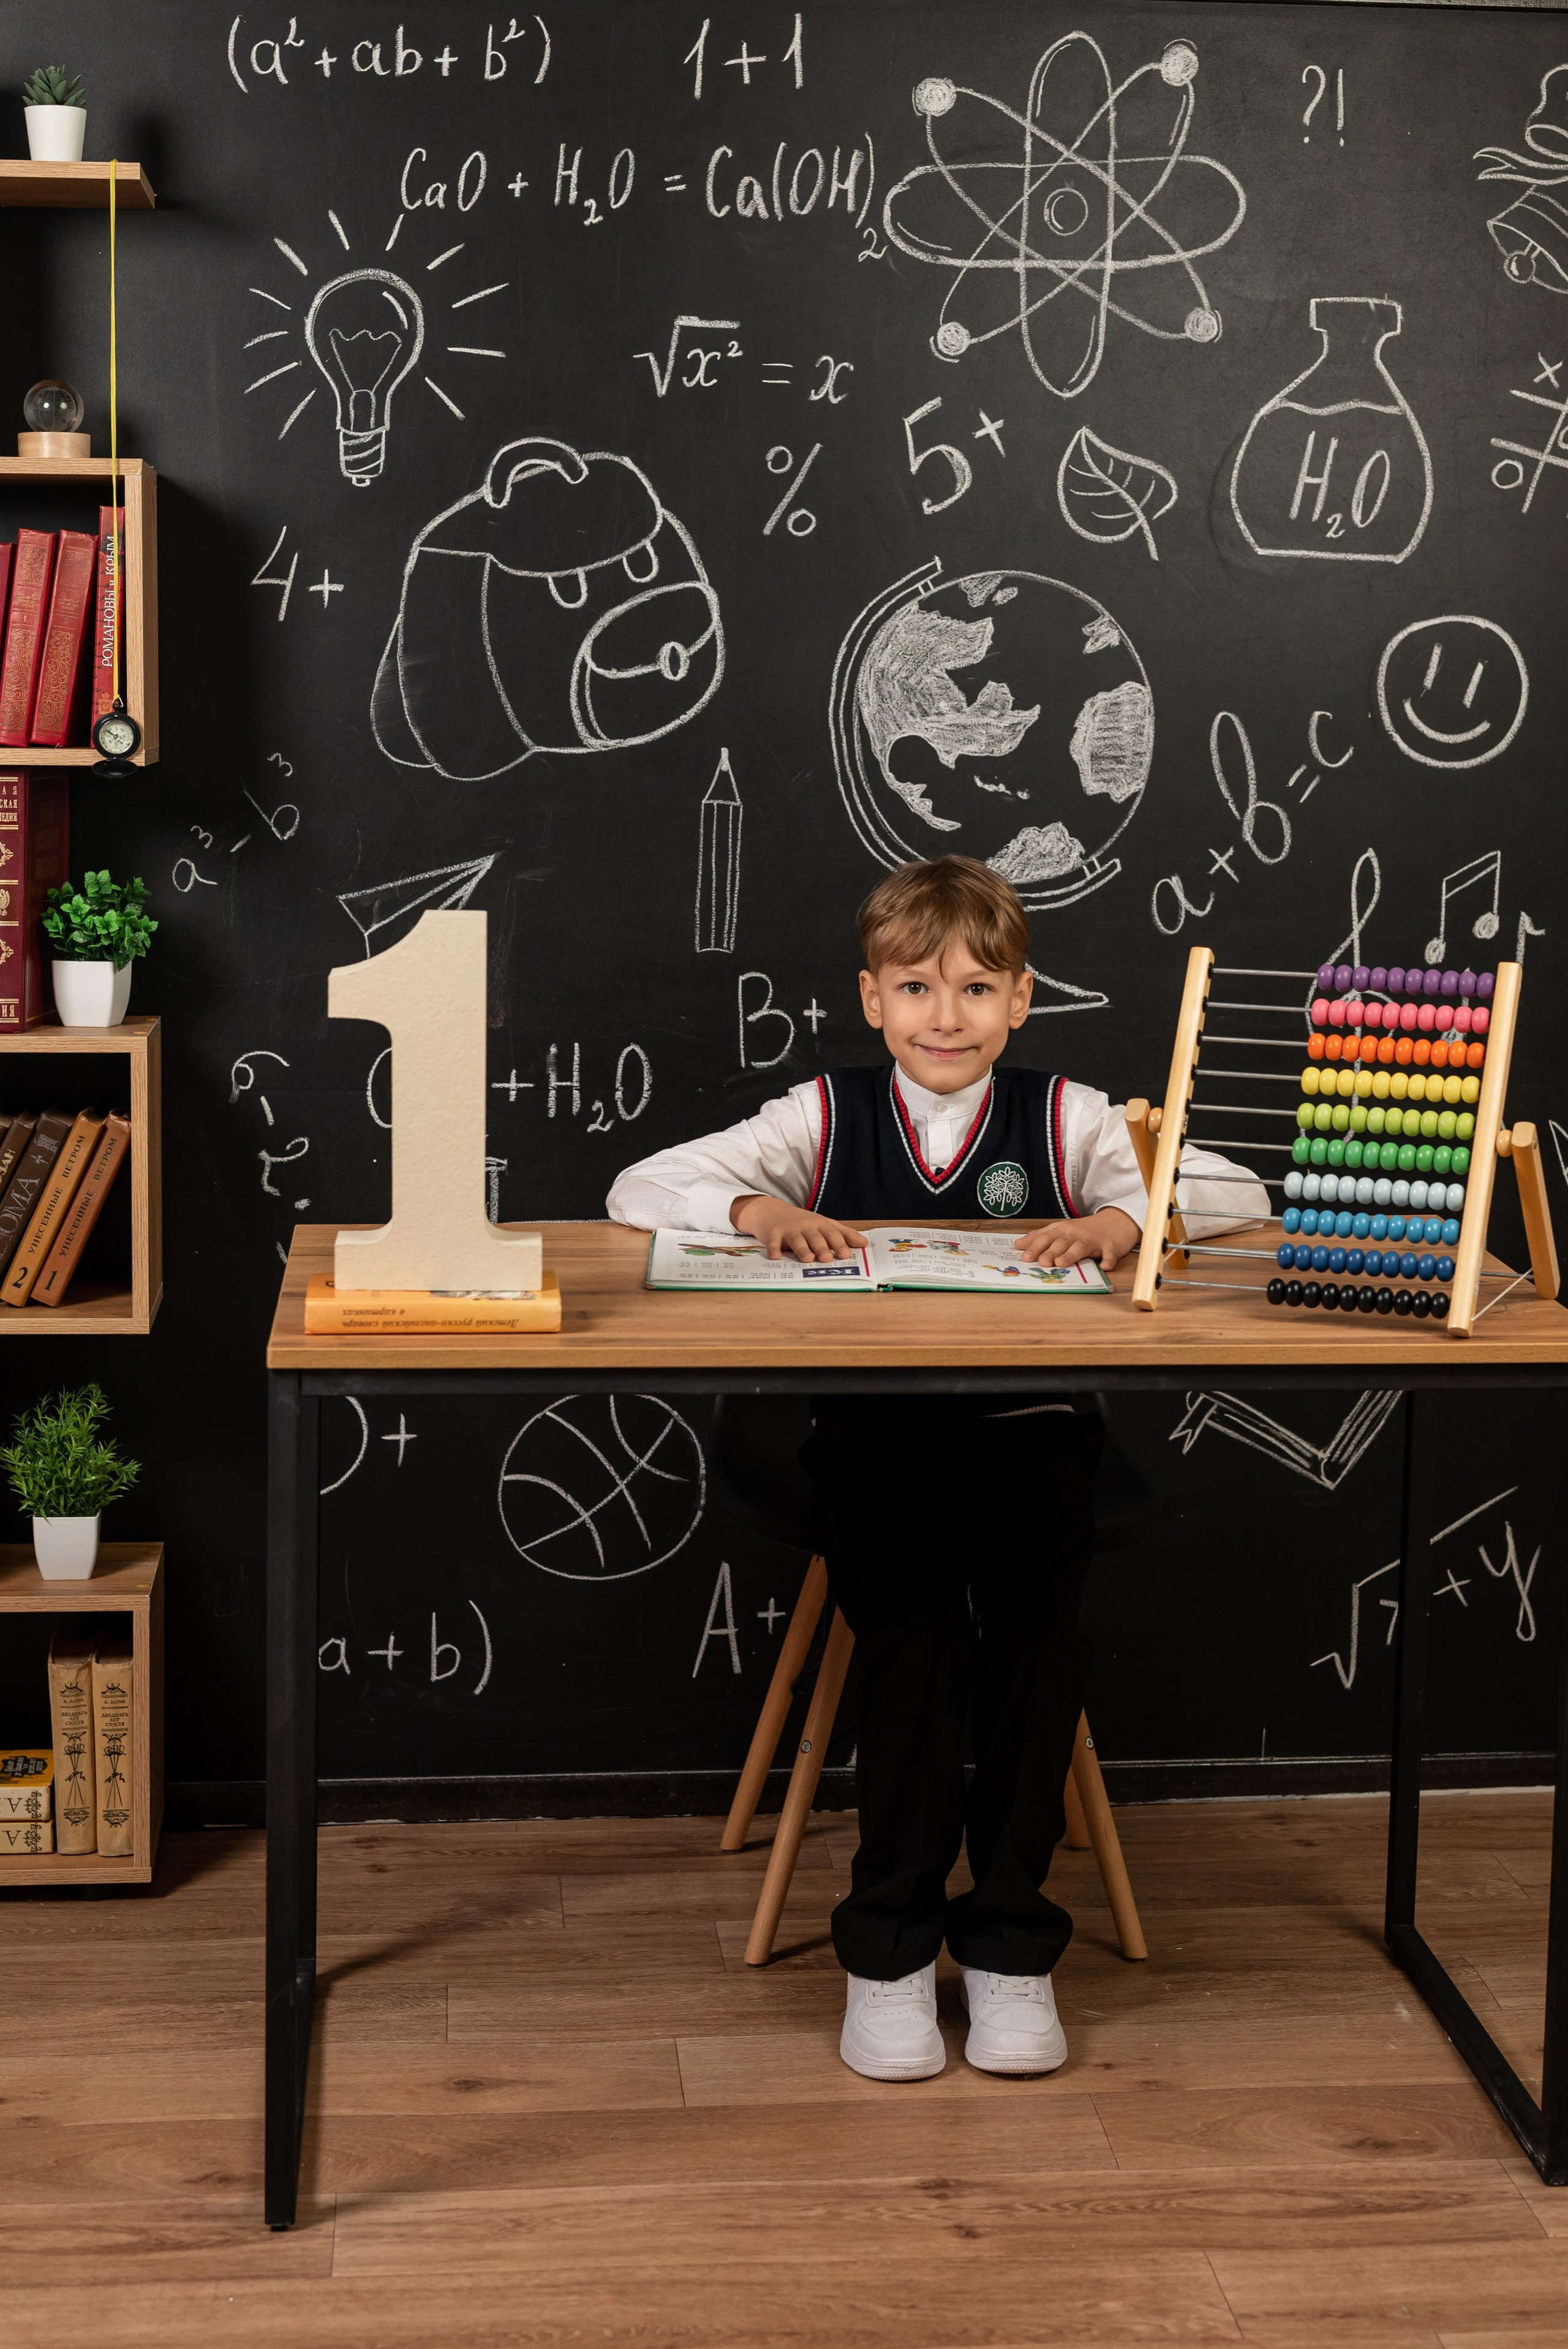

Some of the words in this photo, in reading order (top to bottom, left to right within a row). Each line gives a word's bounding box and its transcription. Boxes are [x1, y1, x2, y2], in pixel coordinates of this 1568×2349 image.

[763, 442, 823, 536] %
[102, 590, 115, 667] РОМАНОВЫ
[28, 1187, 63, 1254] УНЕСЕННЫЕ
[62, 1135, 85, 1179] ВЕТРОМ
[59, 1189, 94, 1257] УНЕСЕННЫЕ
[93, 1137, 117, 1181] ВЕТРОМ
[12, 1267, 28, 1289] 2
[44, 1270, 58, 1292] 1
